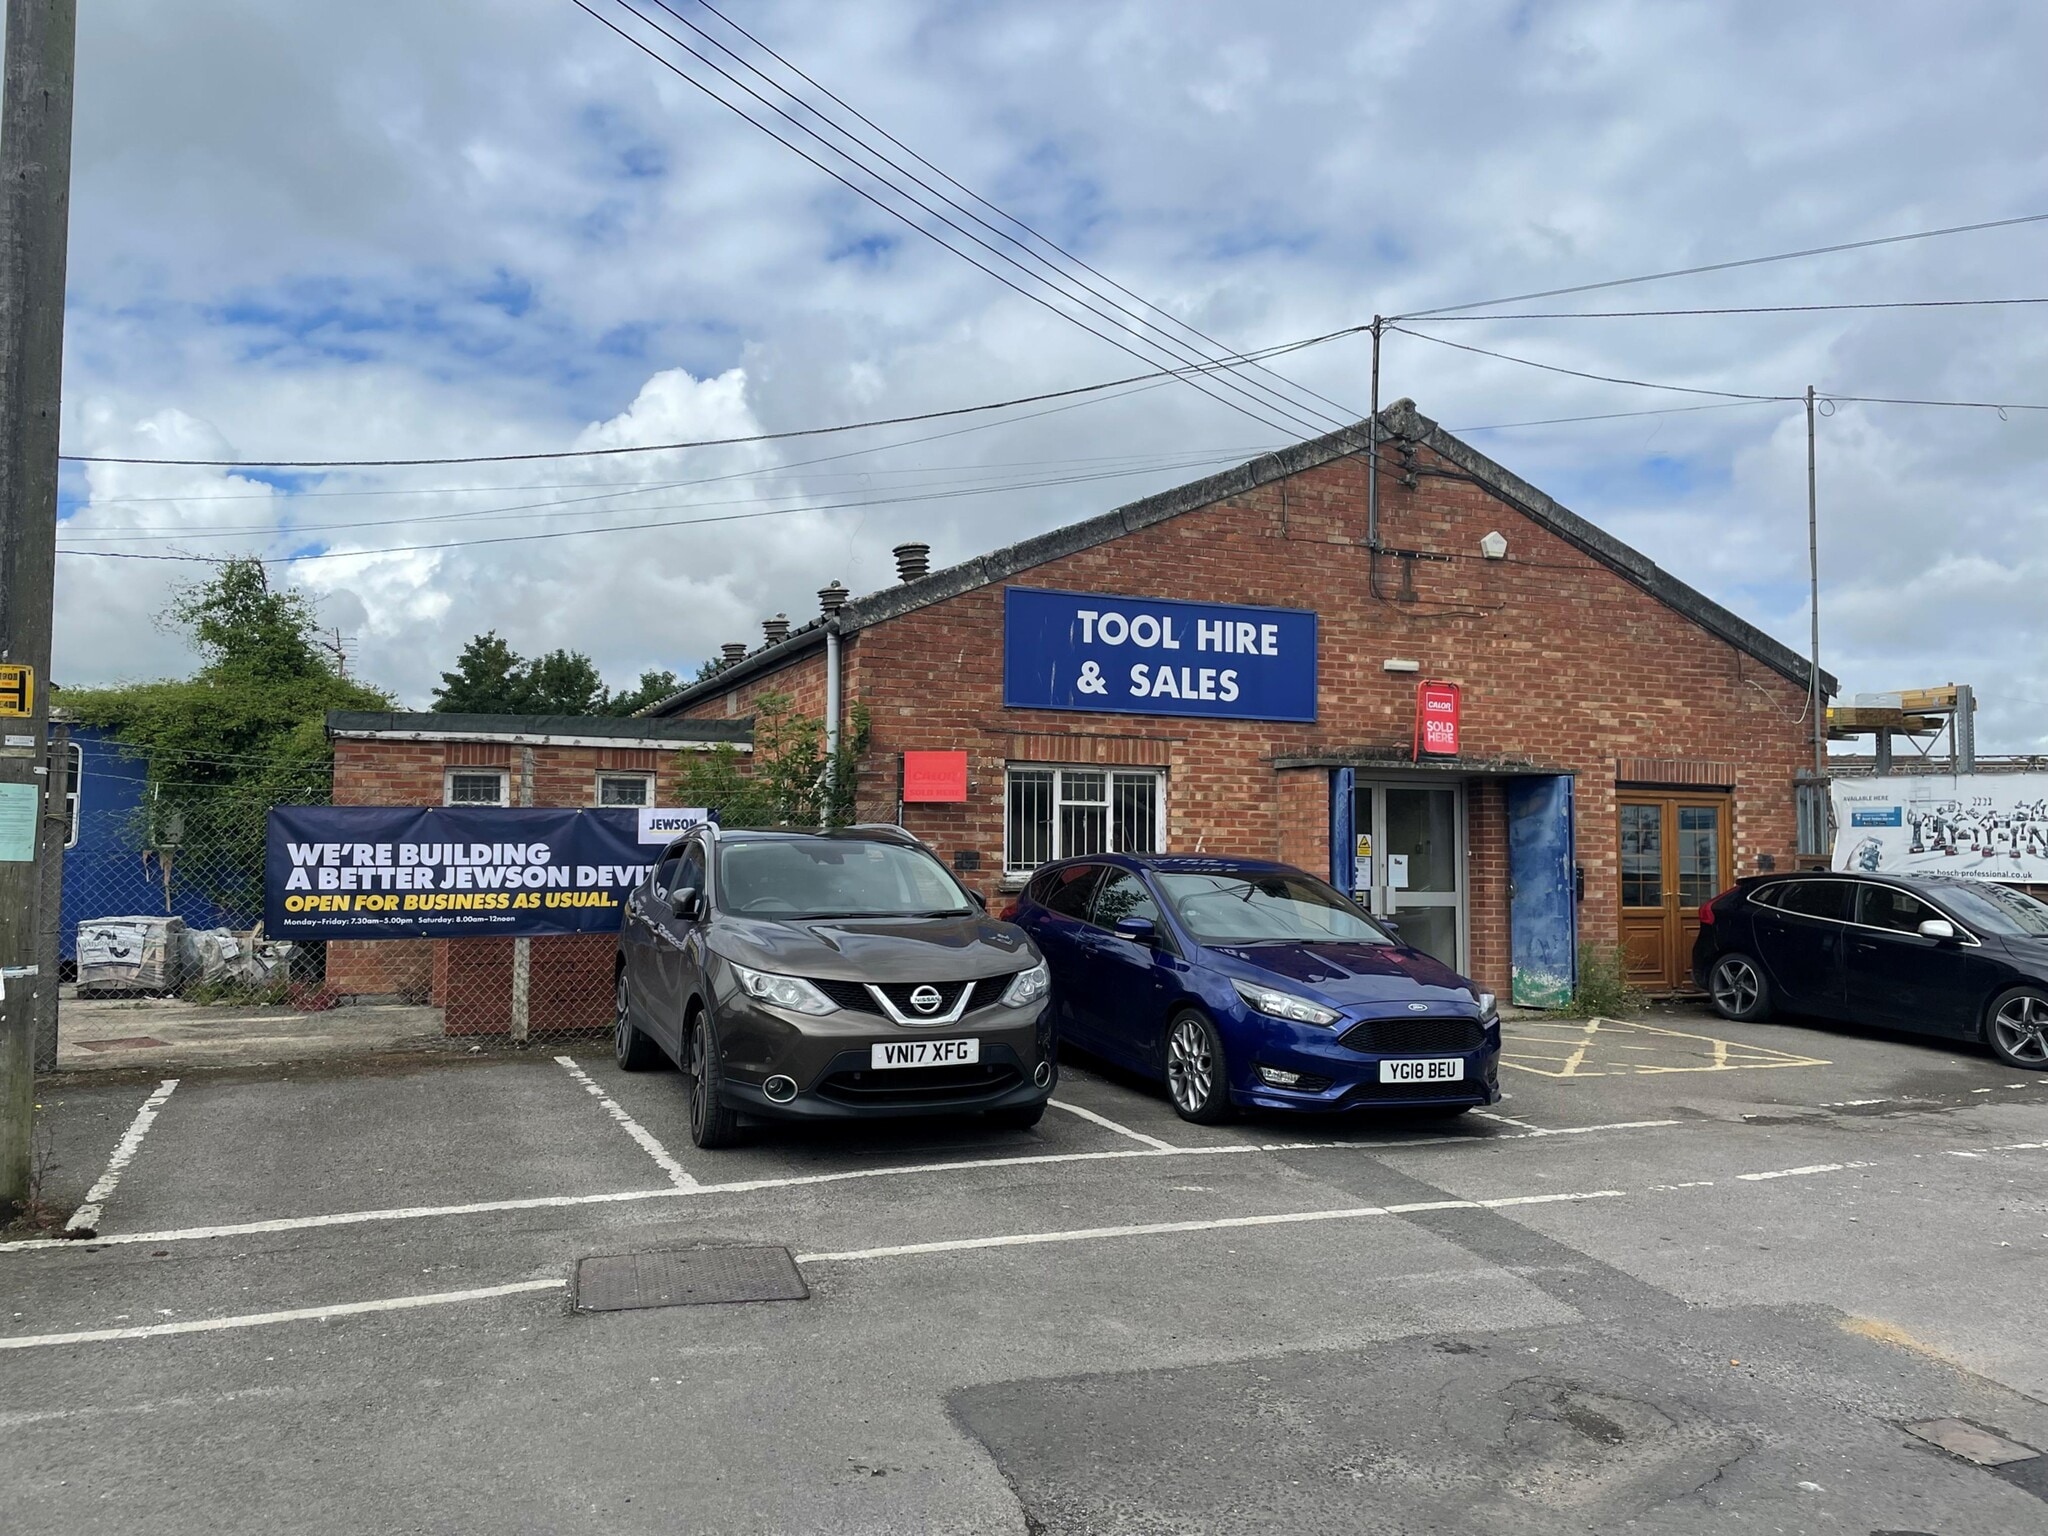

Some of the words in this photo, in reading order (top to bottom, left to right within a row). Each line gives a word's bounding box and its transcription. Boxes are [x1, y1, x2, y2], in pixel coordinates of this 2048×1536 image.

[1077, 610, 1180, 649] TOOL
[1197, 619, 1278, 656] HIRE
[1076, 660, 1108, 695] &
[1129, 663, 1240, 702] SALES
[1428, 701, 1451, 711] CALOR
[1426, 720, 1454, 733] SOLD
[1427, 731, 1454, 744] HERE
[649, 818, 697, 830] JEWSON
[286, 843, 392, 866] WE'RE
[400, 843, 551, 866] BUILDING
[285, 867, 312, 890] A
[318, 866, 435, 890] BETTER
[439, 865, 570, 889] JEWSON
[284, 895, 350, 912] OPEN
[354, 894, 400, 911] FOR
[403, 893, 509, 911] BUSINESS
[512, 893, 542, 908] AS
[545, 892, 618, 907] USUAL.
[885, 1044, 927, 1064] VN17
[932, 1042, 968, 1062] XFG
[1390, 1063, 1424, 1079] YG18
[1428, 1061, 1456, 1078] BEU
